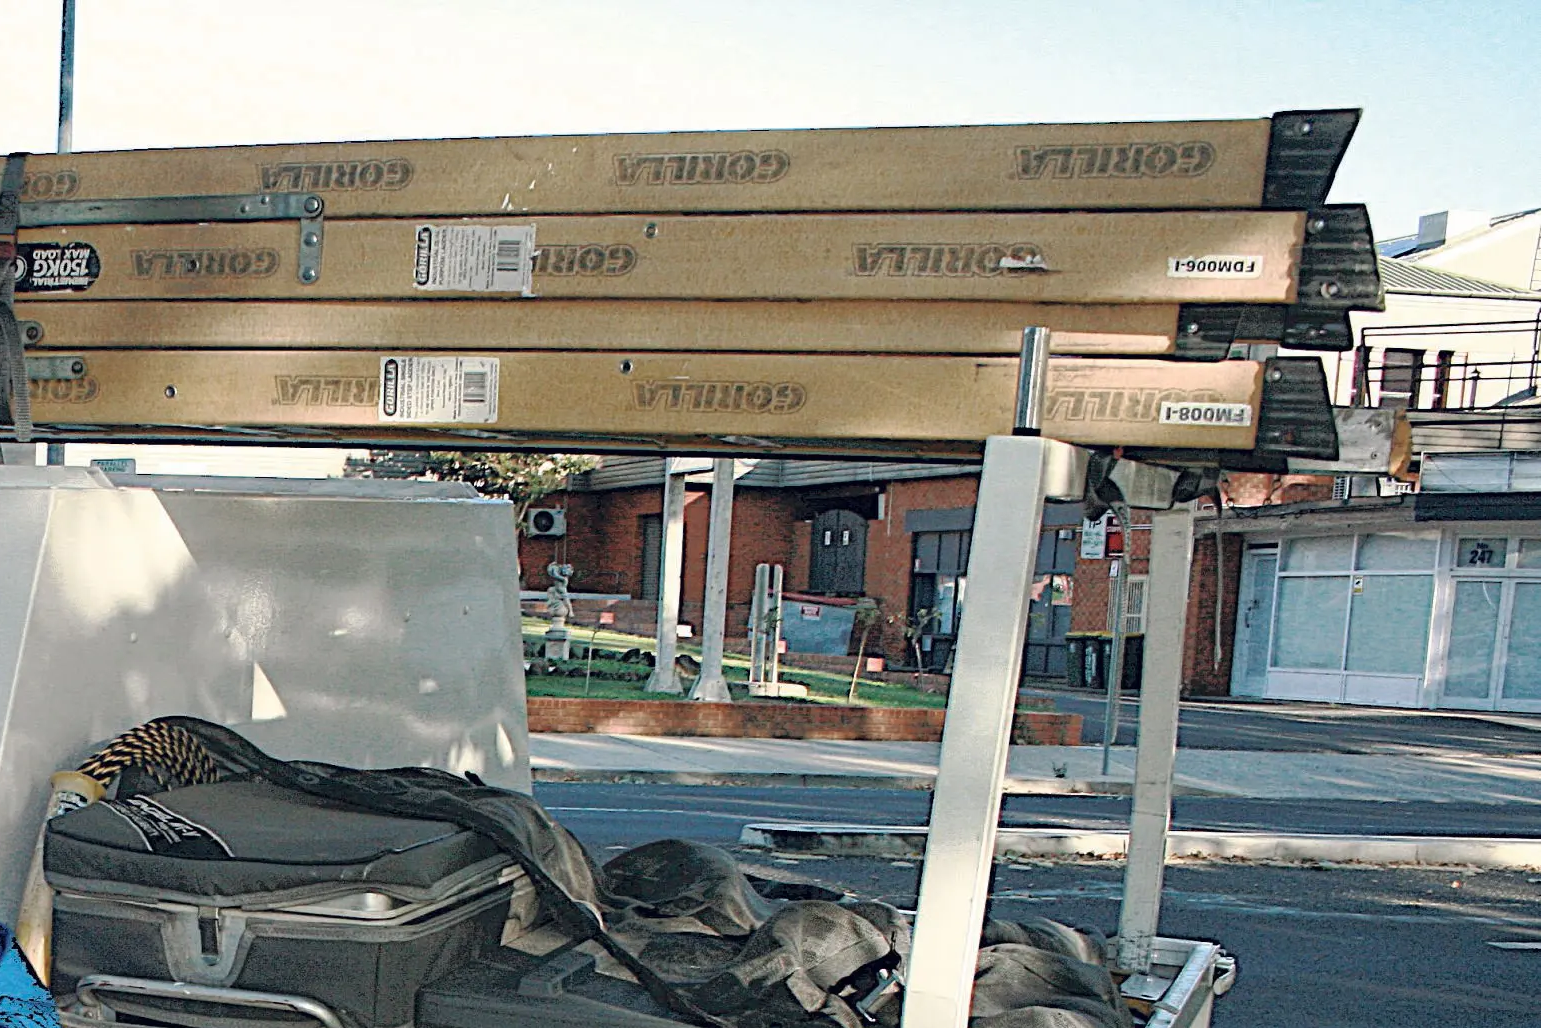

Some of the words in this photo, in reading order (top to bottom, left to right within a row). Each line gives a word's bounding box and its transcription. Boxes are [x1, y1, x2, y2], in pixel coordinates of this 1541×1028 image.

[259, 158, 414, 192] GORILLA
[613, 150, 790, 186] GORILLA
[1015, 141, 1217, 180] GORILLA
[32, 248, 61, 260] LOAD
[33, 258, 89, 278] 150KG
[63, 248, 90, 260] MAX
[130, 249, 280, 280] GORILLA
[534, 243, 638, 277] GORI
[274, 375, 379, 407] RILLA
[385, 362, 397, 415] GORILLA
[632, 379, 807, 414] GORILLA
[1165, 406, 1245, 423] FM008-I
[1468, 550, 1494, 565] 247
